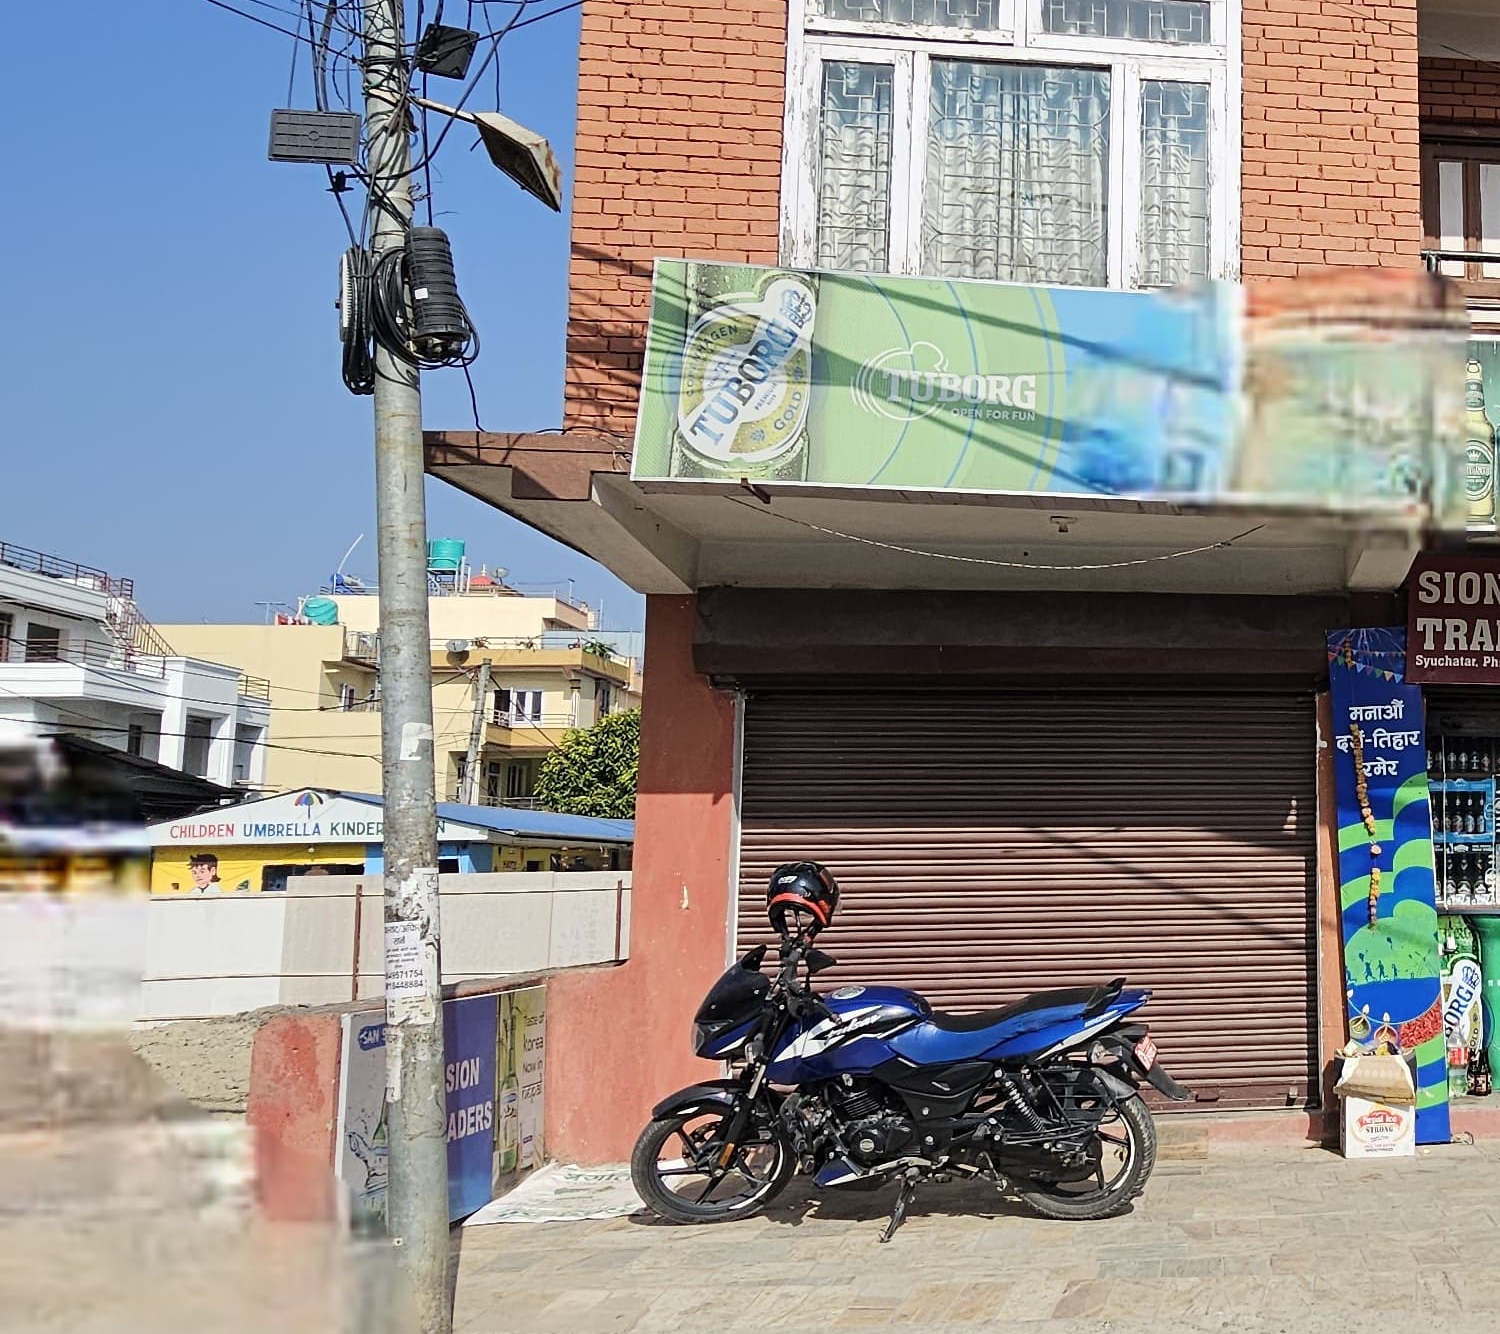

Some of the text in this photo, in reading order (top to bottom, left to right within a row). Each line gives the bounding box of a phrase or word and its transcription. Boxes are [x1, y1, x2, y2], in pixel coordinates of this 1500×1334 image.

[690, 318, 798, 446] TUBORG
[882, 368, 1036, 409] TUBORG
[774, 391, 802, 431] GOLD
[951, 408, 1036, 422] OPEN FOR FUN
[170, 820, 446, 839] CHILDREN UMBRELLA KINDERN
[446, 1057, 480, 1092] SION
[446, 1101, 493, 1144] ADERS
